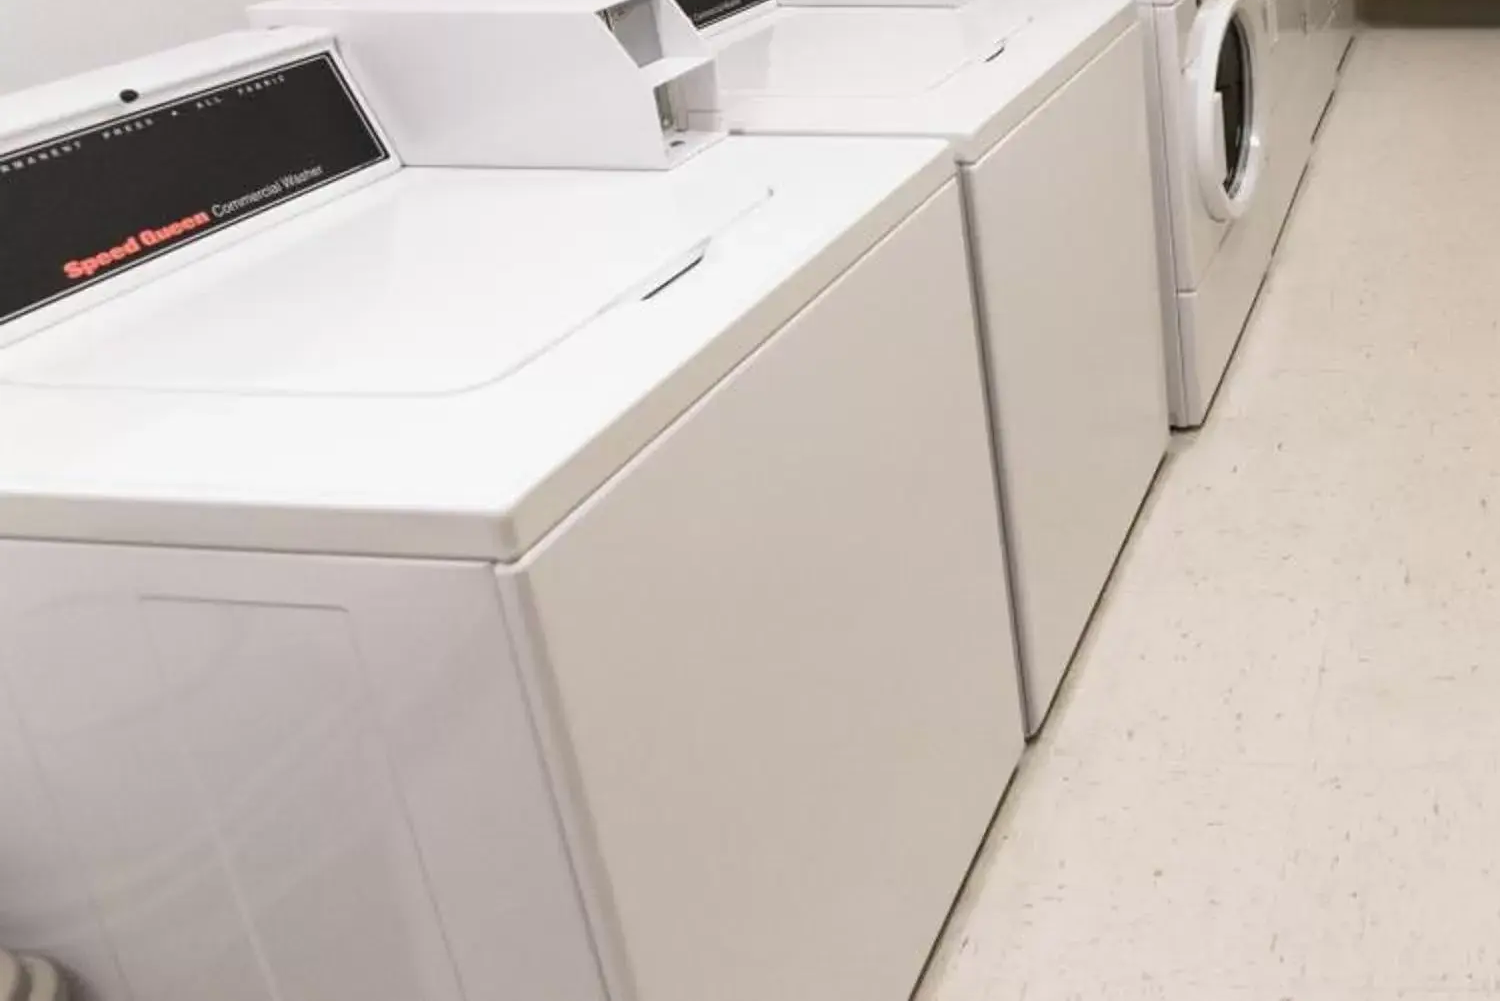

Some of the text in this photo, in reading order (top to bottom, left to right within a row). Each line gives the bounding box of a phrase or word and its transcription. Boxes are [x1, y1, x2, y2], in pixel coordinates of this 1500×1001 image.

[63, 164, 324, 279] Speed Queen Commercial Washer
